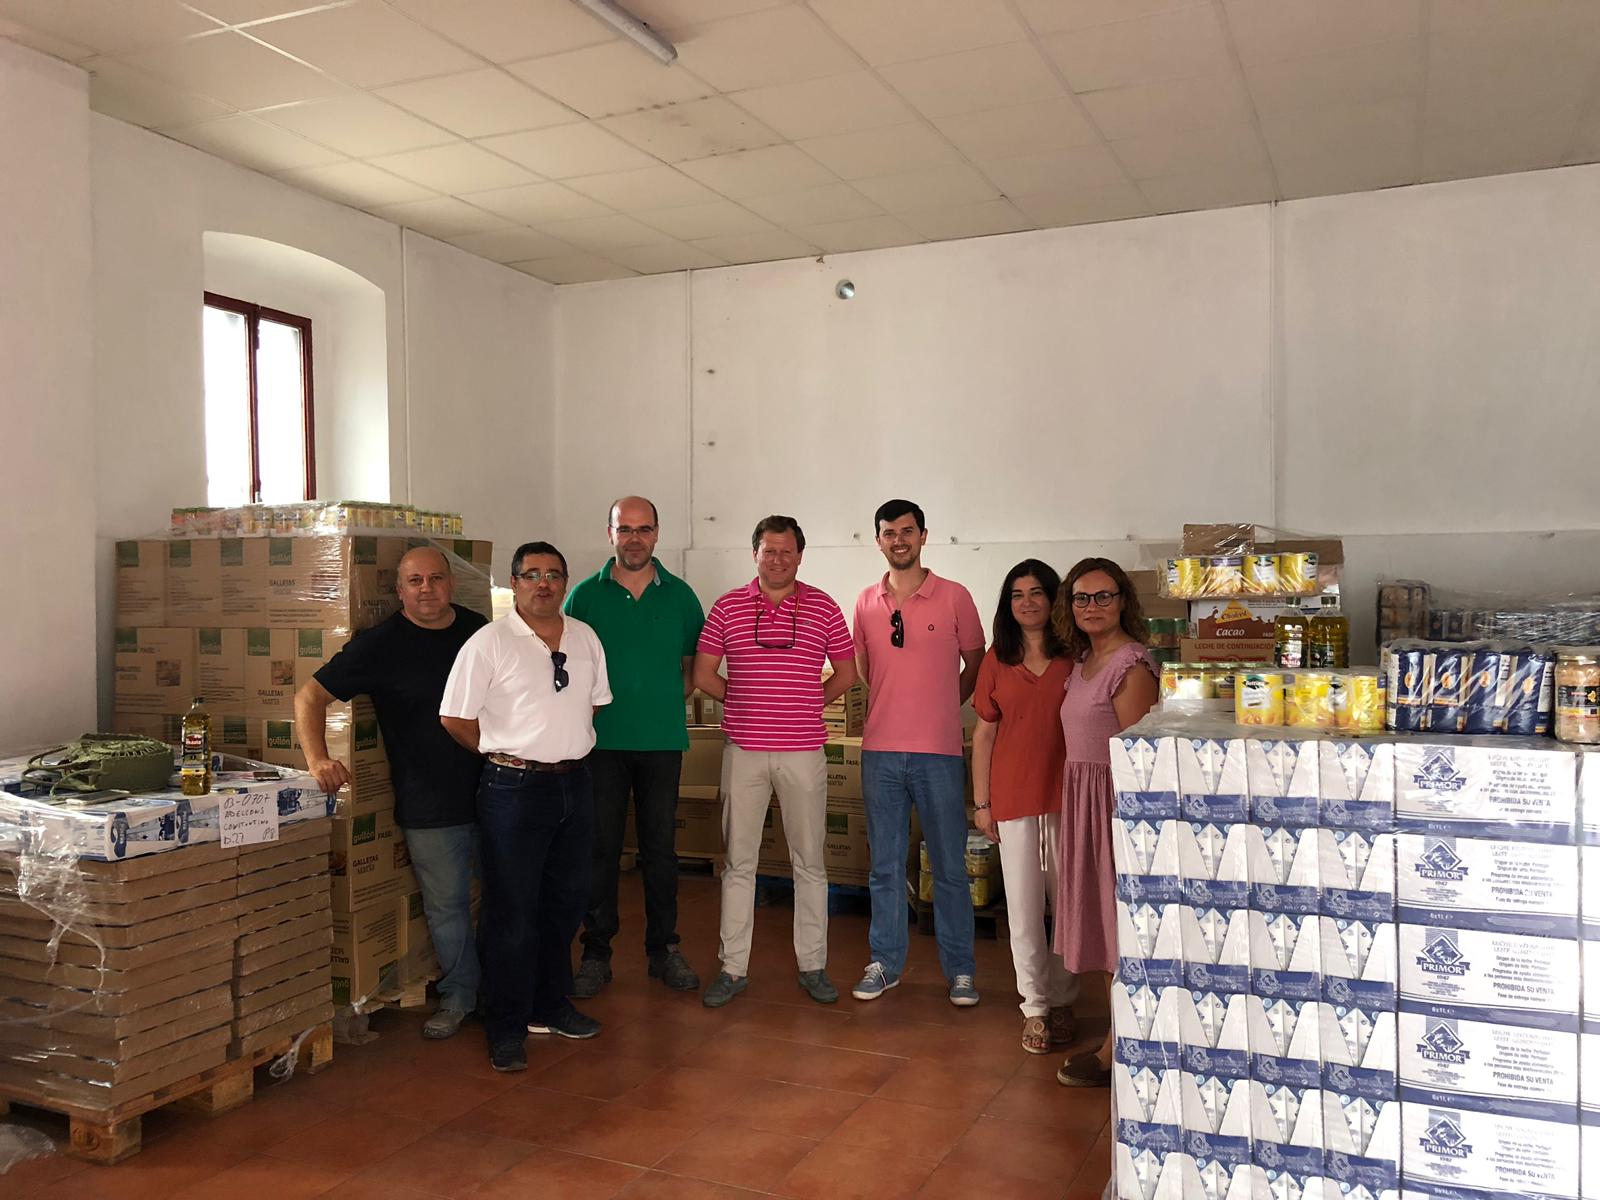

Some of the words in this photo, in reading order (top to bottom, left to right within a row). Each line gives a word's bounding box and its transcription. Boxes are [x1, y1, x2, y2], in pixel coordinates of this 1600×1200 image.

[1420, 781, 1461, 791] PRIMOR
[353, 830, 375, 844] gullón
[352, 854, 379, 867] GALLETAS
[1422, 869, 1462, 880] PRIMOR
[1424, 963, 1462, 974] PRIMOR
[1493, 982, 1525, 992] PROHIBIDA
[1424, 1051, 1462, 1063] PRIMOR
[1493, 1072, 1524, 1081] PROHIBIDA
[1426, 1145, 1464, 1157] PRIMOR
